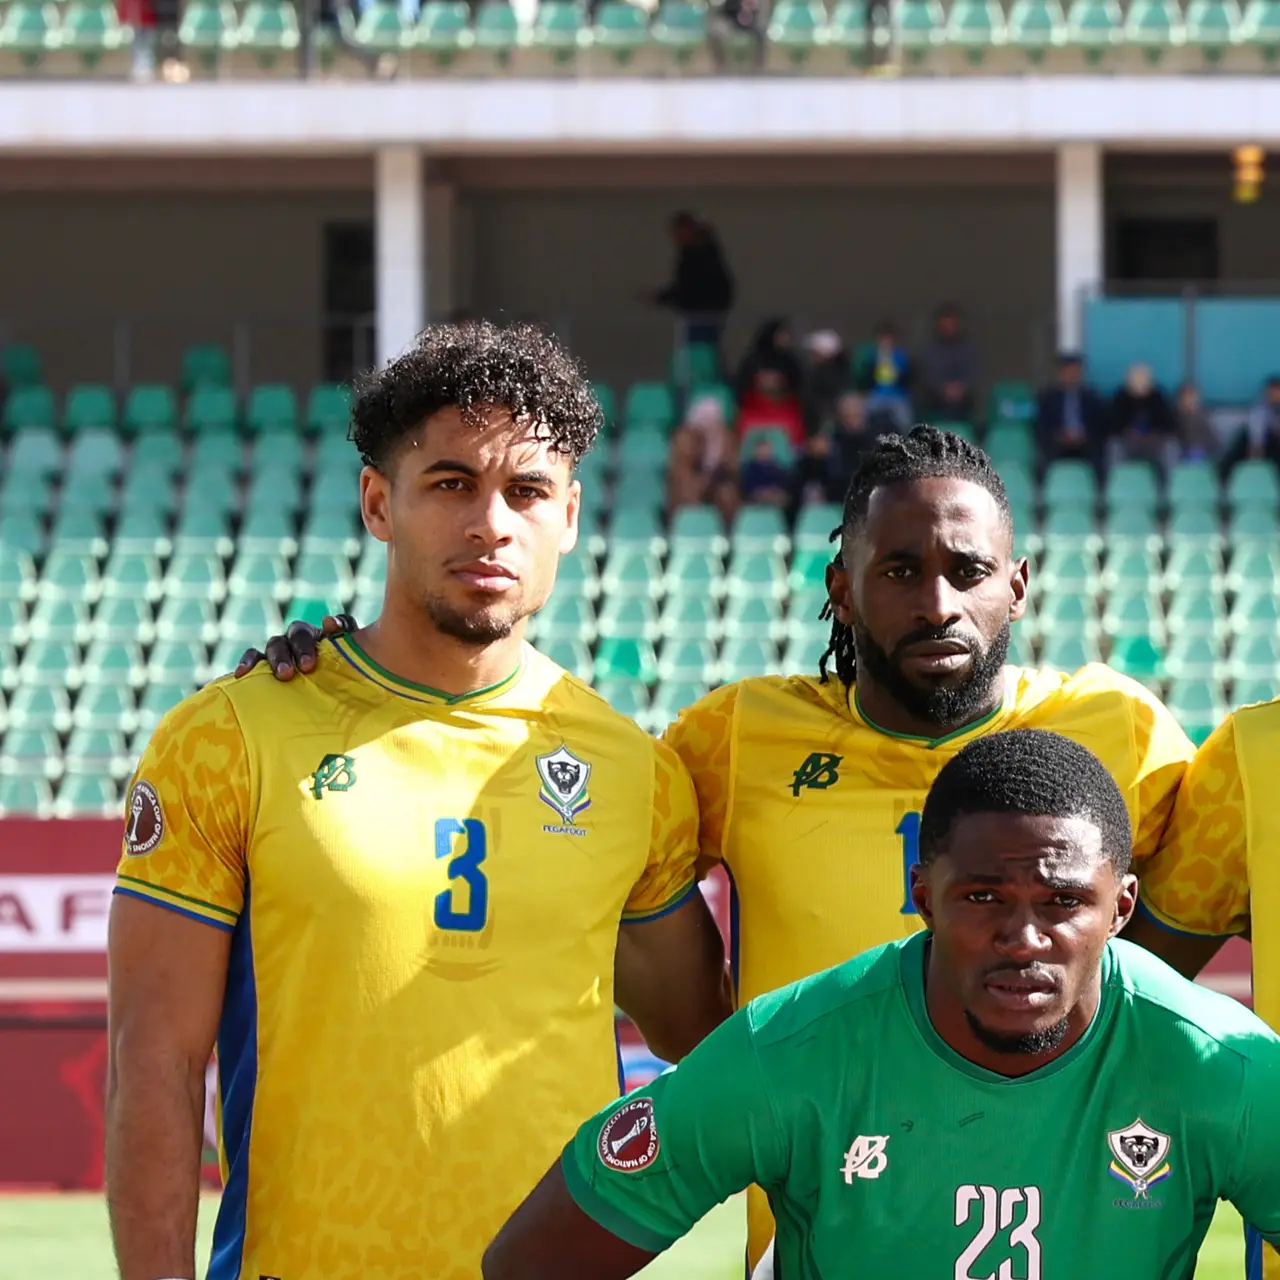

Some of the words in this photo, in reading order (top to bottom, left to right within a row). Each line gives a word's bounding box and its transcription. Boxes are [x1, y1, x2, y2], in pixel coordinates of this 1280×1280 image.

[542, 824, 587, 837] FEGAFOOT
[433, 817, 488, 932] 3
[894, 811, 922, 915] 1
[601, 1113, 621, 1155] MOROCCO
[605, 1154, 639, 1168] NATIONS
